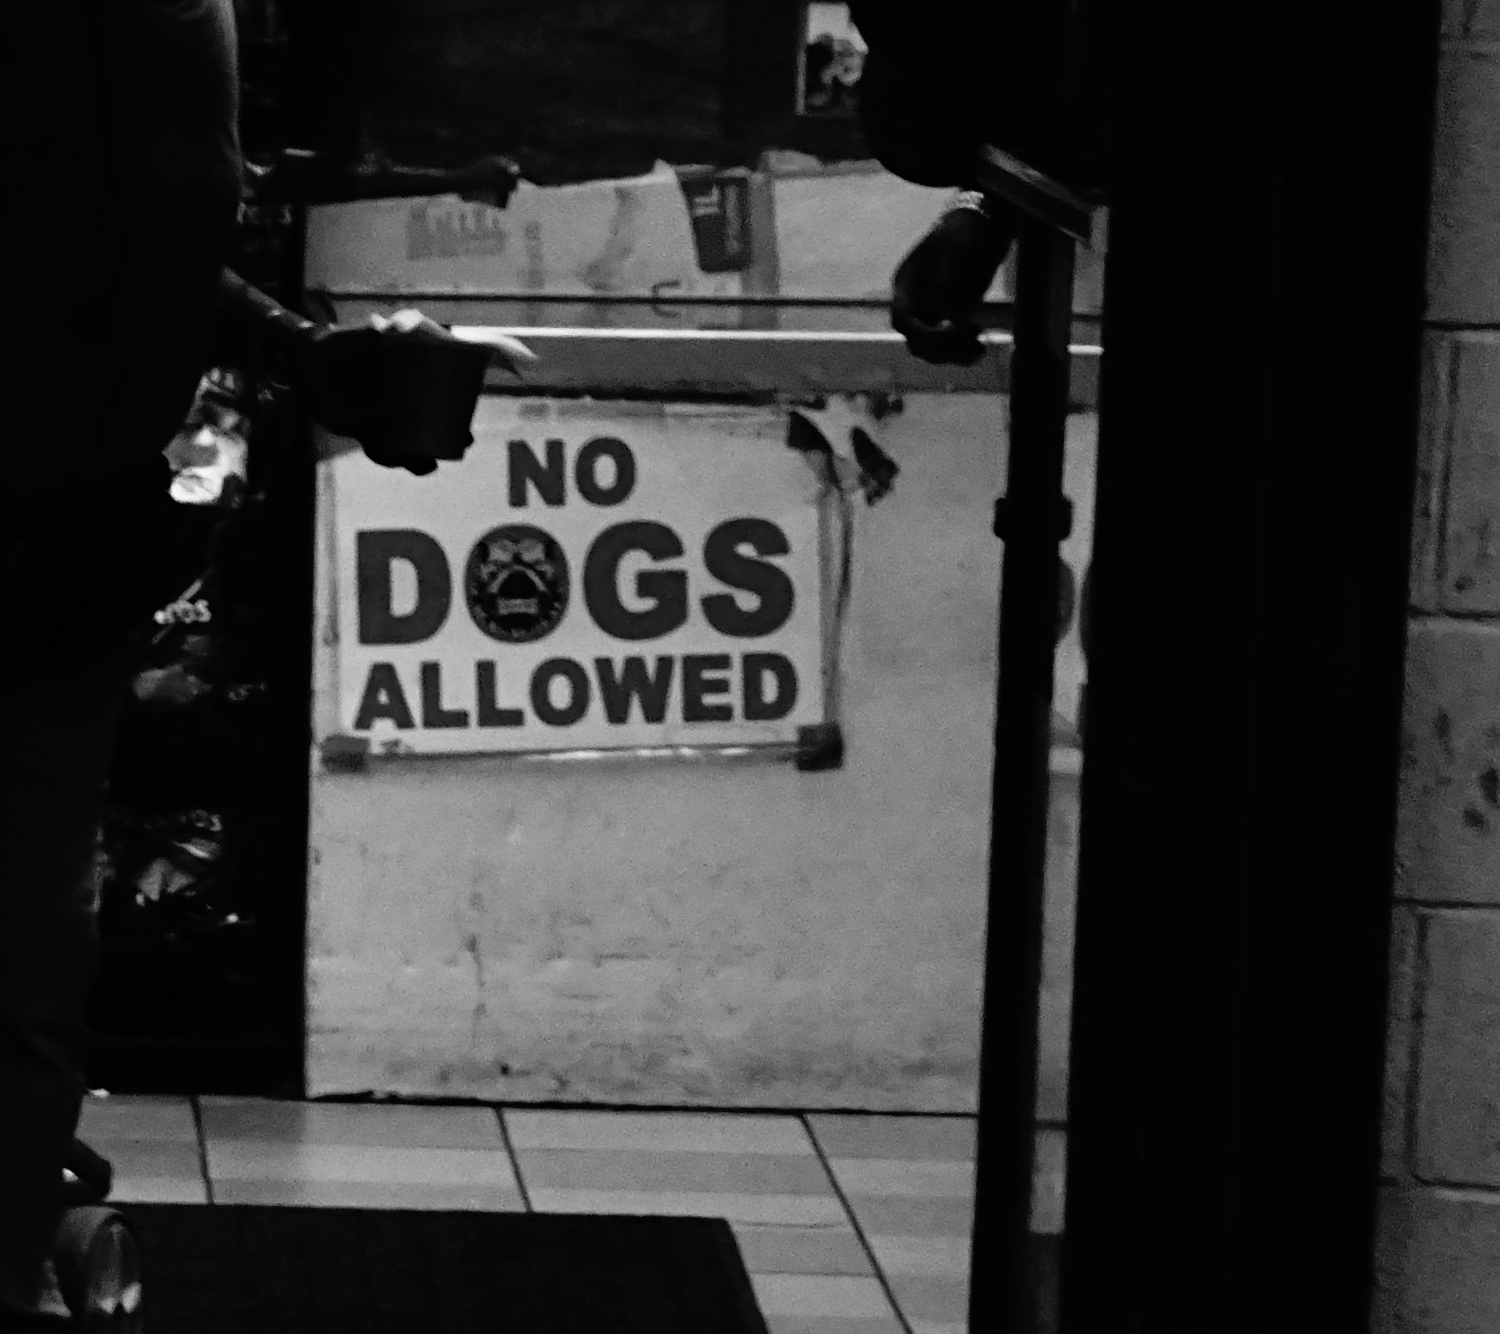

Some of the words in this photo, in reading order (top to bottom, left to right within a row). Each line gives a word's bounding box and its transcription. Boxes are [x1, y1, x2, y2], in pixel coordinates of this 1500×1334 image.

[506, 435, 638, 509] NO
[355, 517, 796, 646] DOGS
[353, 651, 798, 731] ALLOWED
